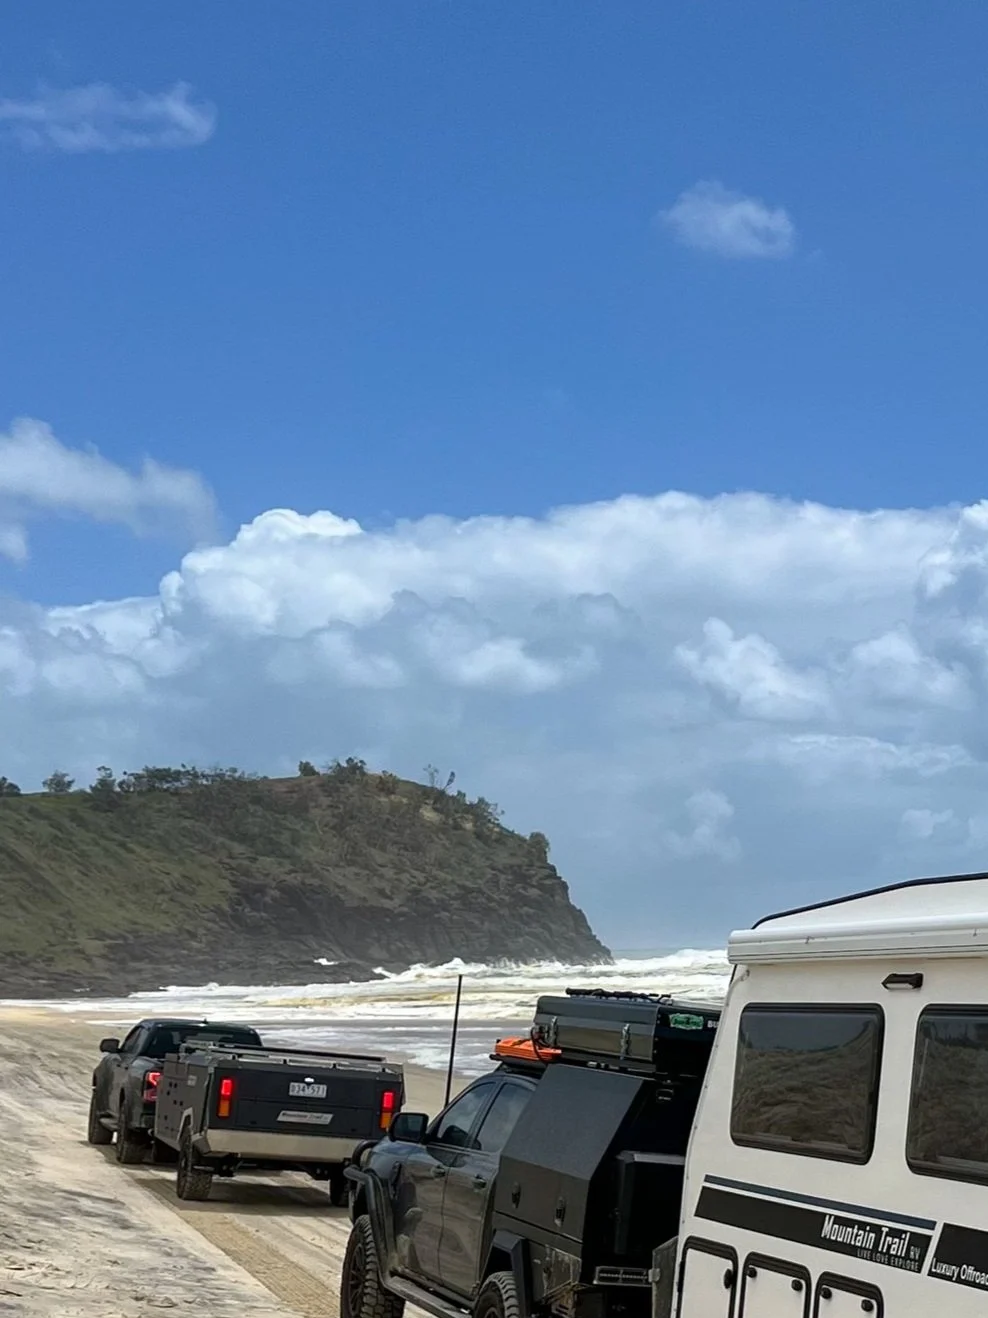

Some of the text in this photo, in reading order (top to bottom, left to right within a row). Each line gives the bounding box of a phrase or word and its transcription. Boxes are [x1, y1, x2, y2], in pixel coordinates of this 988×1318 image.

[821, 1214, 921, 1260] Mountain Trail RV
[857, 1248, 919, 1271] LIVE LOVE EXPLORE
[931, 1257, 960, 1281] Luxury
